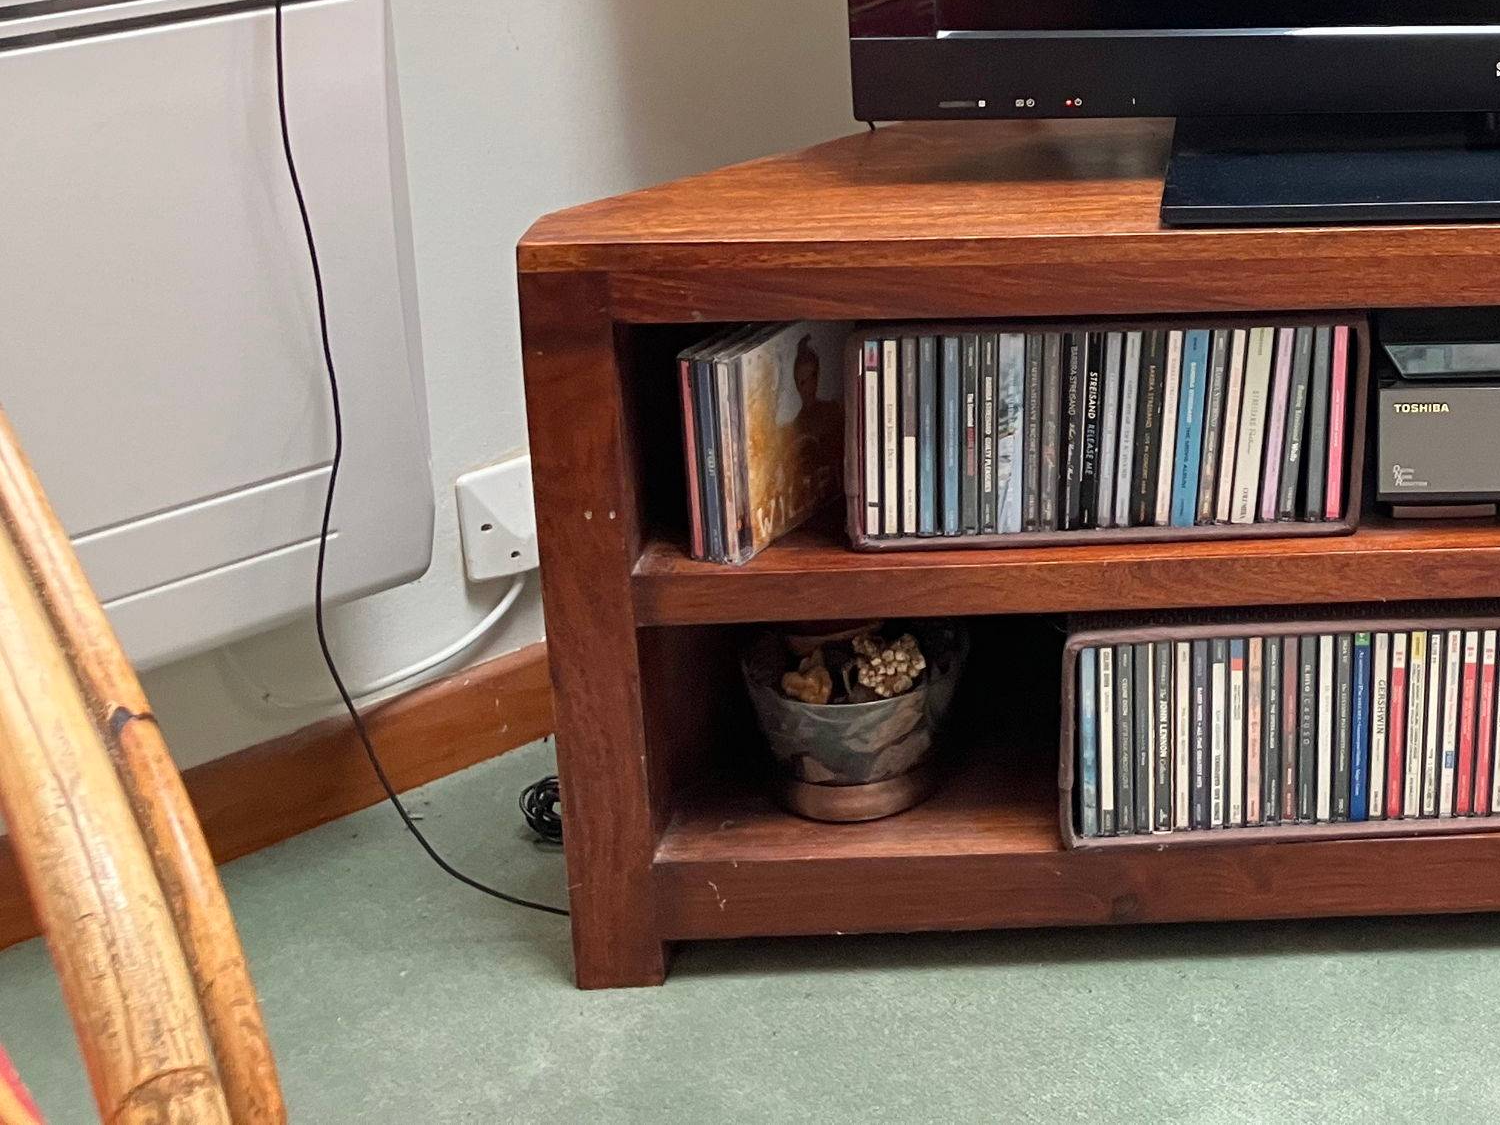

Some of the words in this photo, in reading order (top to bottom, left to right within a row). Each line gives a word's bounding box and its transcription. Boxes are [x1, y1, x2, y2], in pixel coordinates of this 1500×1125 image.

[1068, 376, 1076, 415] STREISAND
[1088, 371, 1098, 419] STREISAND
[1393, 403, 1450, 413] TOSHIBA
[1086, 424, 1095, 458] RELEASE
[1085, 461, 1093, 475] ME
[1376, 680, 1386, 734] GERSHWIN
